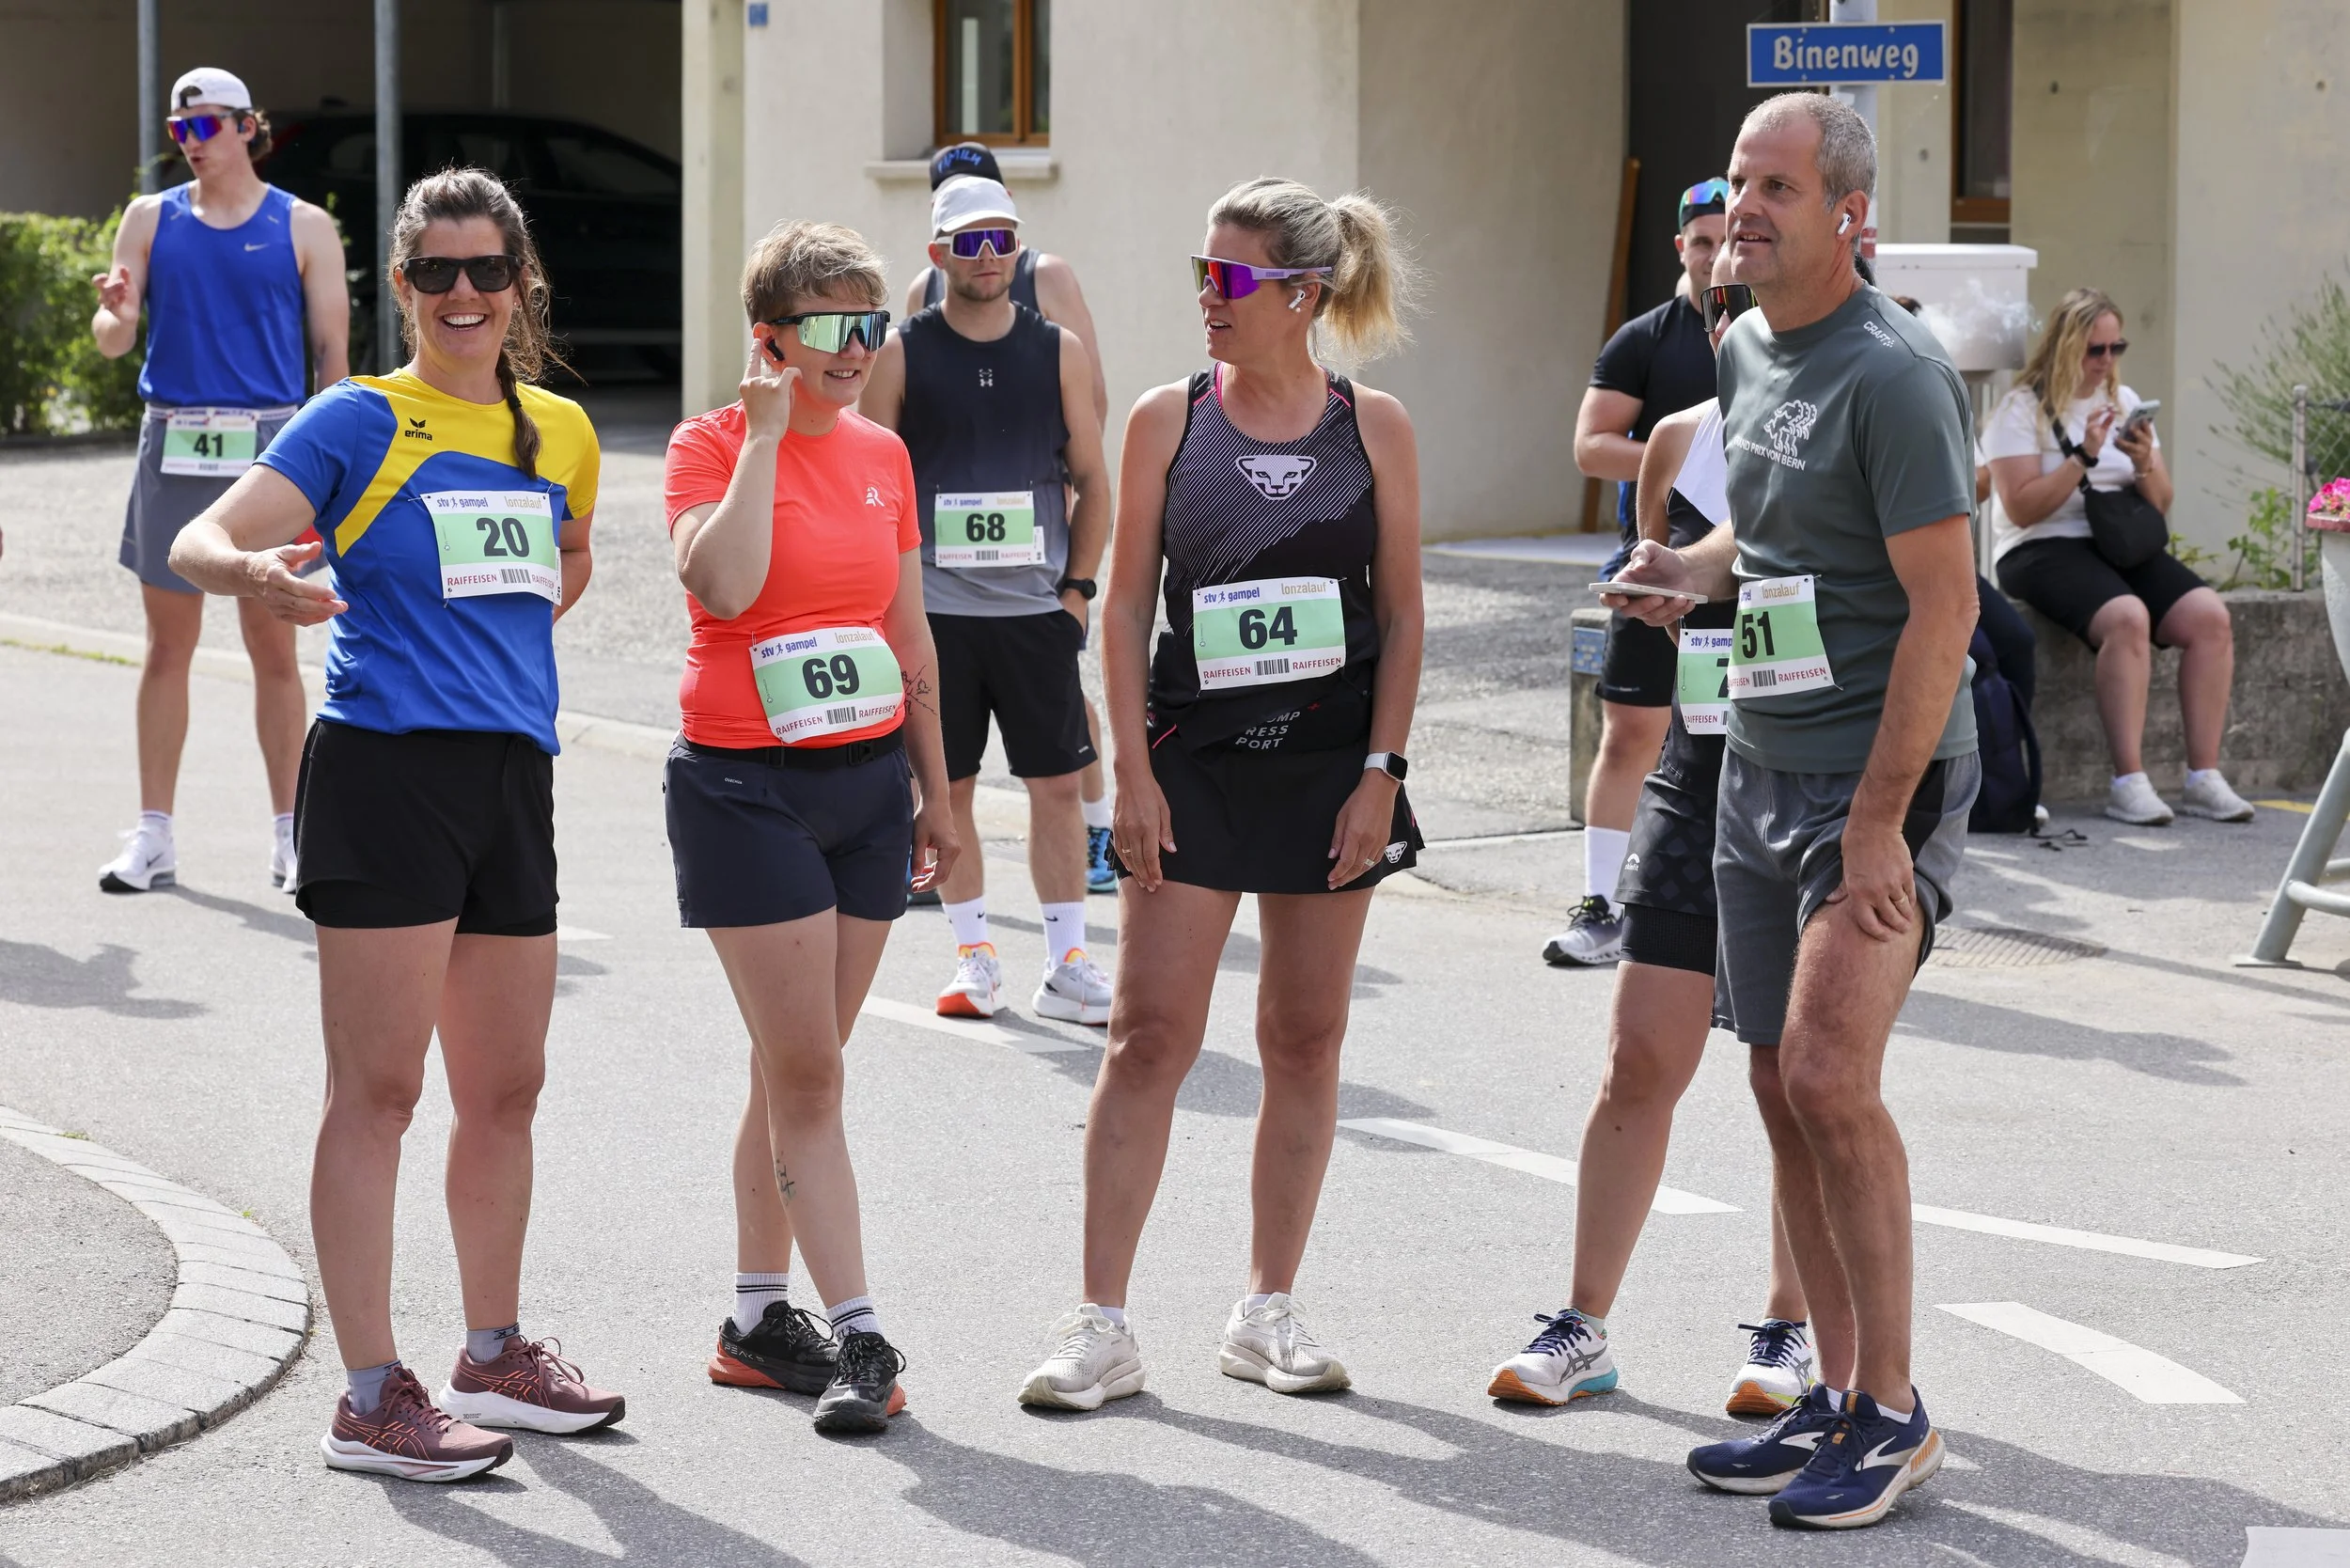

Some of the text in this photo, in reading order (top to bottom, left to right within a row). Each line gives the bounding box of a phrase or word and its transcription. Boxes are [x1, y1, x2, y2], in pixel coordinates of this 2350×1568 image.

[1774, 35, 1919, 79] Binenweg
[1863, 321, 1890, 342] CRAFT
[404, 429, 432, 441] erima
[194, 433, 224, 458] 41
[1750, 442, 1766, 458] PRIX
[1766, 448, 1781, 463] VON
[1781, 455, 1806, 471] BERN
[437, 496, 489, 509] stv gampel
[504, 495, 542, 510] lonzalauf
[966, 512, 1006, 542] 68
[476, 517, 530, 557] 20
[447, 573, 497, 587] RAIFFEISEN
[531, 573, 555, 588] RAIFFEISEN
[1204, 587, 1260, 604] stv gampel
[1281, 582, 1326, 595] lonzalauf
[1762, 581, 1800, 600] lonzalauf
[1239, 606, 1297, 650] 64
[1741, 611, 1775, 659] 51
[835, 631, 875, 644] lonzalauf
[1691, 635, 1732, 648] stv gamp
[760, 636, 818, 659] stv gampel
[1292, 657, 1341, 670] RAIFFEISEN
[802, 654, 859, 699] 69
[1203, 666, 1251, 679] RAIFFEISEN
[1778, 666, 1826, 682] RAIFFEISEN
[858, 704, 897, 718] RAIFFEISEN
[776, 715, 823, 736] RAIFFEISEN
[1235, 737, 1283, 750] PORT
